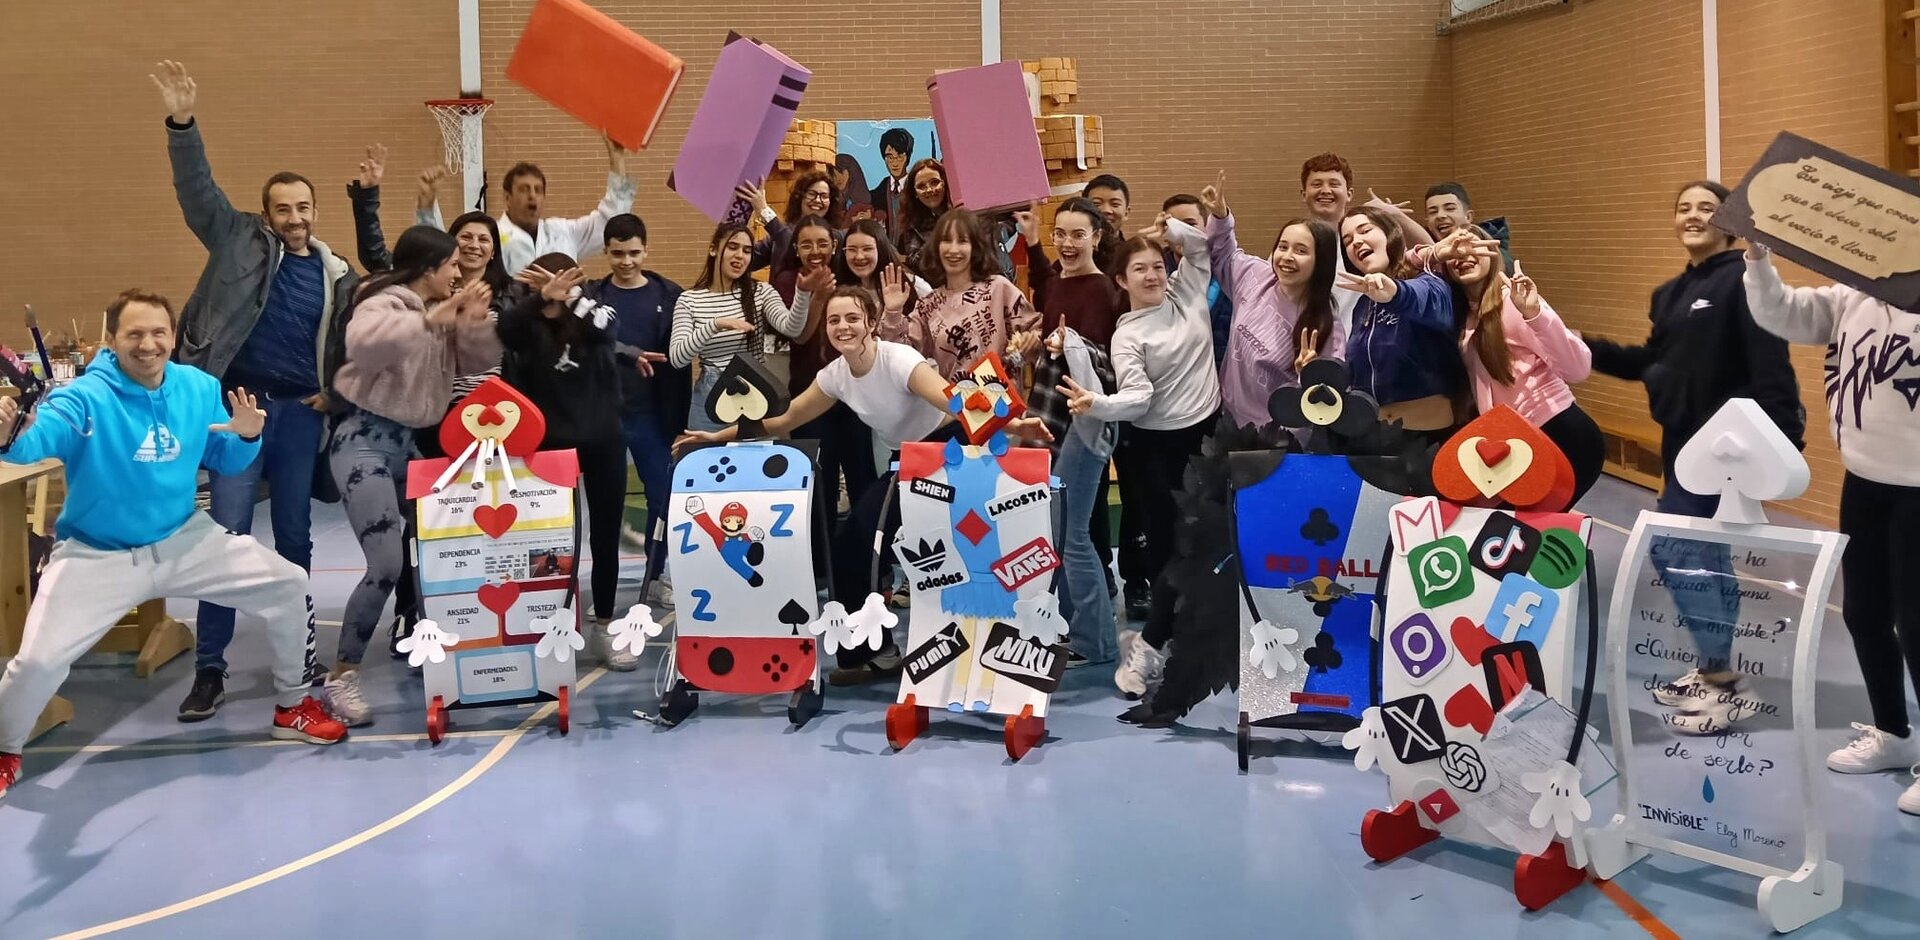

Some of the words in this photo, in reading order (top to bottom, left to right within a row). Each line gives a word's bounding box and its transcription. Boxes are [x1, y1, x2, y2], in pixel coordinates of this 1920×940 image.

[971, 310, 993, 347] THINGS
[981, 305, 998, 336] SOME
[437, 496, 477, 506] TAQUICARDIA
[914, 480, 951, 499] SHIEN
[988, 489, 1048, 517] LACOSTA
[770, 504, 794, 537] Z
[673, 521, 700, 555] Z
[439, 548, 481, 559] DEPENDENCIA
[1746, 550, 1768, 567] ha
[1265, 554, 1309, 573] RED
[1318, 557, 1379, 578] BALL
[446, 607, 479, 617] ANSIEDAD
[526, 604, 558, 613] TRISTEZA
[691, 589, 717, 621] Z
[993, 635, 1056, 677] NIKU
[1737, 652, 1764, 676] ha
[473, 665, 519, 676] ENFERMEDADES
[1662, 713, 1690, 727] vez
[1664, 742, 1692, 760] de
[1703, 755, 1775, 777] serlo?
[1716, 822, 1738, 848] Eloy
[1743, 828, 1787, 849] Moreno
